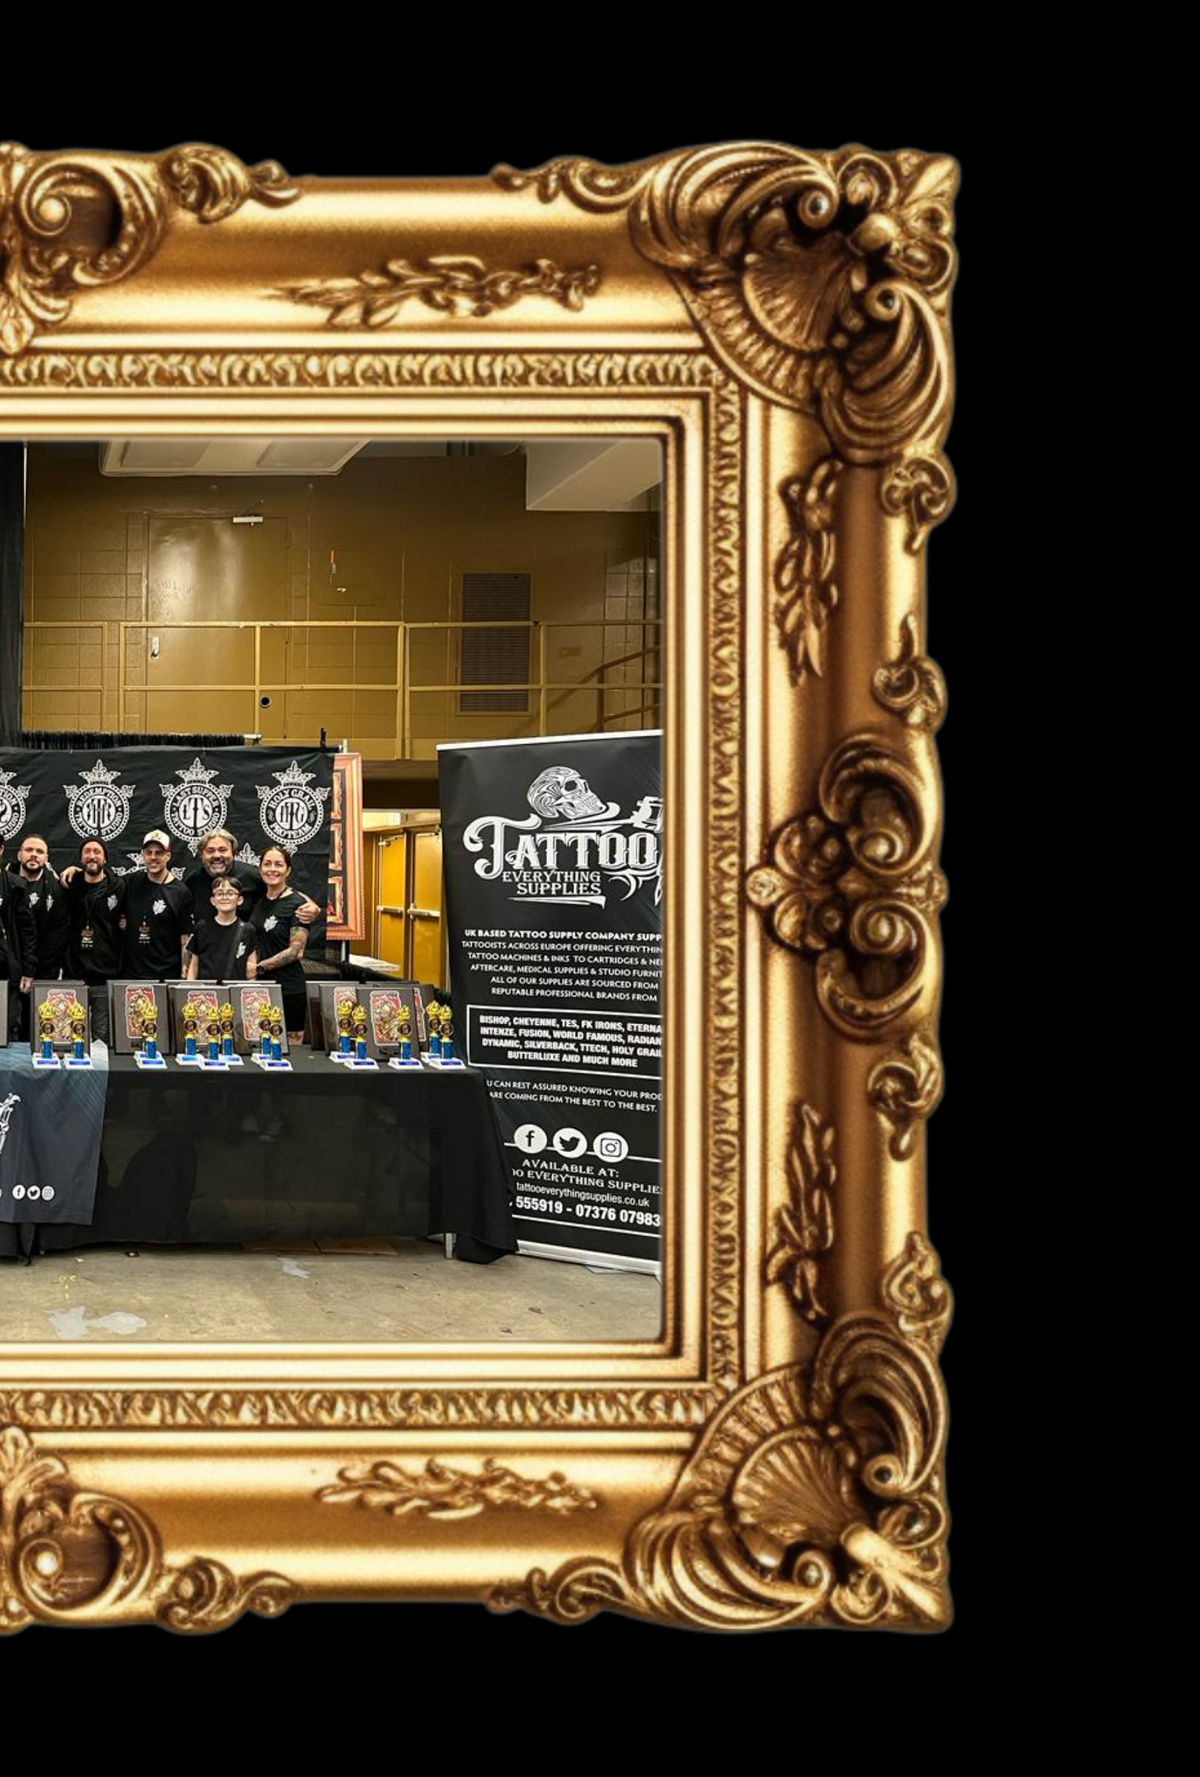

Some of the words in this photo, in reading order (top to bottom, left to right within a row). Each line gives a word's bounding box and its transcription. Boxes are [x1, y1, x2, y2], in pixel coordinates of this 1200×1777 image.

[76, 787, 122, 807] REDEMPTION
[172, 787, 191, 807] LAST
[191, 786, 220, 808] SUPPER
[268, 789, 290, 809] HOLY
[290, 789, 316, 811] GRAIL
[75, 811, 98, 836] TATTOO
[101, 811, 123, 836] STUDIO
[171, 811, 195, 836] TATTOO
[463, 813, 658, 880] TATTOO
[502, 870, 601, 883] EVERYTHING
[517, 882, 602, 896] SUPPLIES
[464, 929, 477, 937] UK
[477, 929, 507, 938] BASED
[507, 930, 547, 939] TATTOO
[548, 931, 583, 940] SUPPLY
[585, 931, 635, 941] COMPANY
[461, 940, 506, 949] TATTOOISTS
[507, 942, 539, 950] ACROSS
[540, 943, 572, 951] EUROPE
[573, 943, 614, 953] OFFERING
[467, 952, 499, 960] TATTOO
[500, 953, 542, 962] MACHINES
[543, 954, 550, 962] &
[551, 954, 570, 963] INKS
[573, 954, 586, 963] TO
[587, 955, 639, 965] CARTRIDGES
[640, 957, 647, 966] &
[470, 963, 516, 973] AFTERCARE,
[516, 965, 552, 974] MEDICAL
[553, 966, 589, 975] SUPPLIES
[590, 967, 597, 975] &
[598, 967, 631, 976] STUDIO
[490, 976, 505, 984] ALL
[506, 976, 517, 984] OF
[518, 976, 537, 985] OUR
[538, 977, 573, 986] SUPPLIES
[574, 978, 590, 987] ARE
[591, 979, 632, 989] SOURCED
[632, 981, 659, 990] FROM
[491, 987, 534, 997] REPUTABLE
[535, 988, 595, 999] PROFESSIONAL
[596, 991, 630, 1001] BRANDS
[631, 992, 658, 1002] FROM
[479, 1015, 511, 1026] BISHOP,
[512, 1016, 560, 1028] CHEYENNE,
[561, 1018, 579, 1029] TES,
[595, 1020, 625, 1032] IRONS,
[480, 1026, 517, 1038] INTENZE,
[518, 1028, 551, 1039] FUSION,
[552, 1029, 584, 1040] WORLD
[586, 1031, 625, 1044] FAMOUS,
[482, 1038, 522, 1049] DYNAMIC,
[524, 1040, 579, 1052] SILVERBACK,
[580, 1043, 610, 1055] TTECH,
[611, 1045, 635, 1055] HOLY
[507, 1050, 560, 1062] BUTTERLUXE
[561, 1053, 580, 1063] AND
[582, 1055, 609, 1065] MUCH
[611, 1056, 638, 1068] MORE
[493, 1080, 511, 1088] CAN
[512, 1081, 531, 1089] REST
[532, 1082, 568, 1092] ASSURED
[569, 1085, 612, 1096] KNOWING
[613, 1088, 638, 1099] YOUR
[504, 1091, 538, 1102] COMING
[539, 1094, 563, 1103] FROM
[564, 1096, 580, 1105] THE
[582, 1097, 601, 1107] BEST
[603, 1099, 616, 1108] TO
[617, 1100, 635, 1110] THE
[635, 1103, 657, 1113] BEST.
[521, 1158, 594, 1175] AVAILABLE
[597, 1167, 619, 1178] AT:
[527, 1170, 604, 1188] EVERYTHING
[516, 1181, 650, 1208] tattooeverythingsupplies.co.uk
[515, 1195, 563, 1214] 555919
[575, 1203, 616, 1221] 07376
[619, 1209, 661, 1227] 07983
